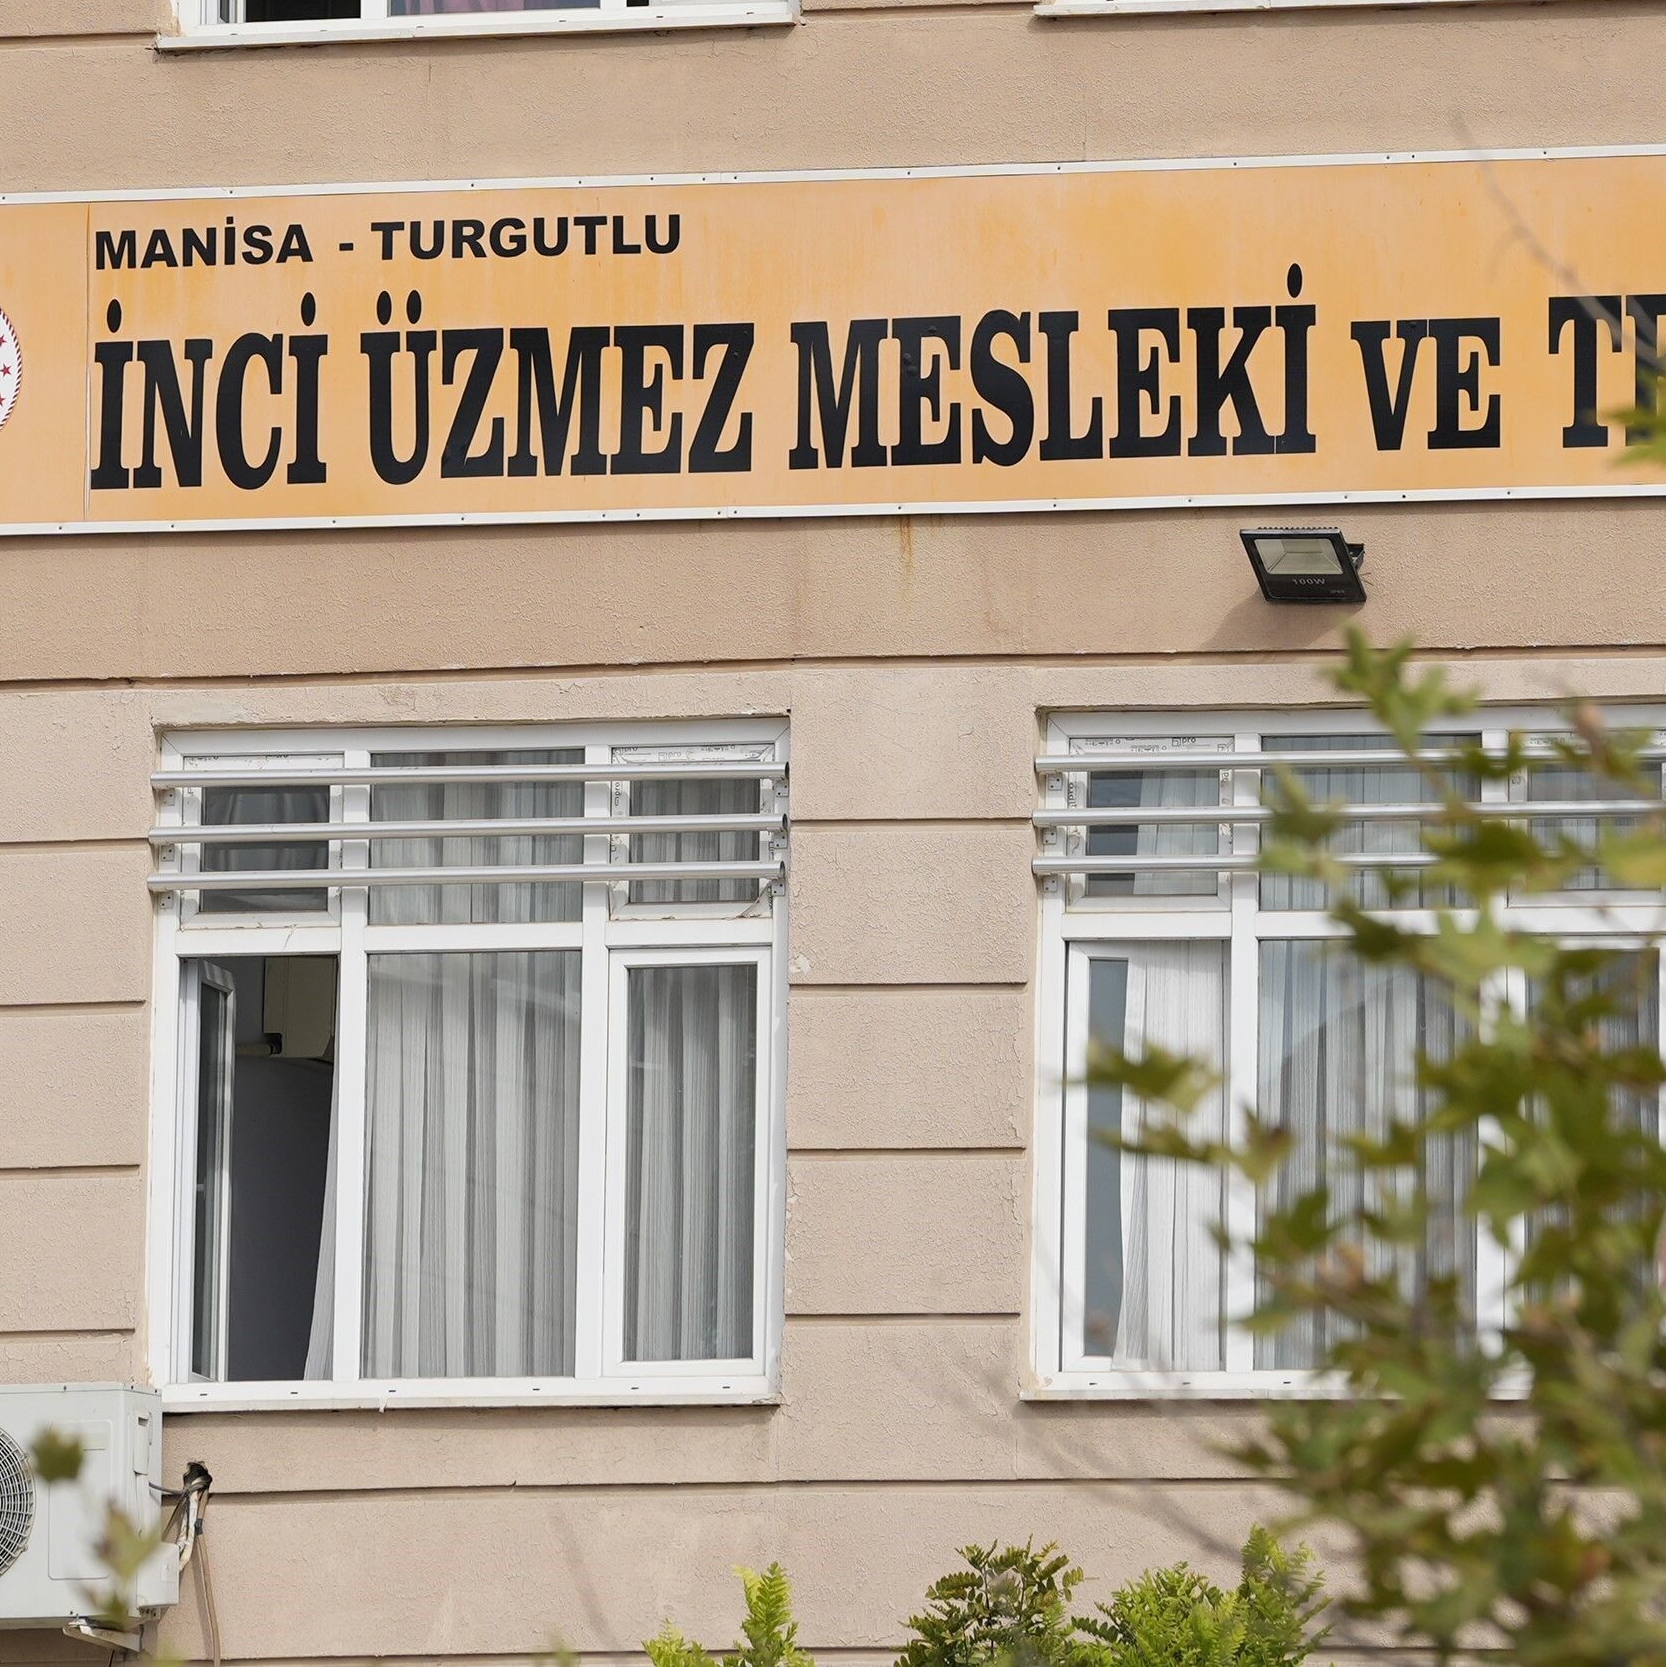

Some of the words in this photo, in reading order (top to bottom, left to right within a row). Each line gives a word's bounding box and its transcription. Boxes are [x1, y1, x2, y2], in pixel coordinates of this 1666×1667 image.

[95, 217, 313, 270] MANİSA
[370, 214, 681, 261] TURGUTLU
[90, 291, 328, 491] İNCİ
[360, 288, 755, 485] ÜZMEZ
[789, 262, 1317, 469] MESLEKİ
[1350, 317, 1501, 451] VE
